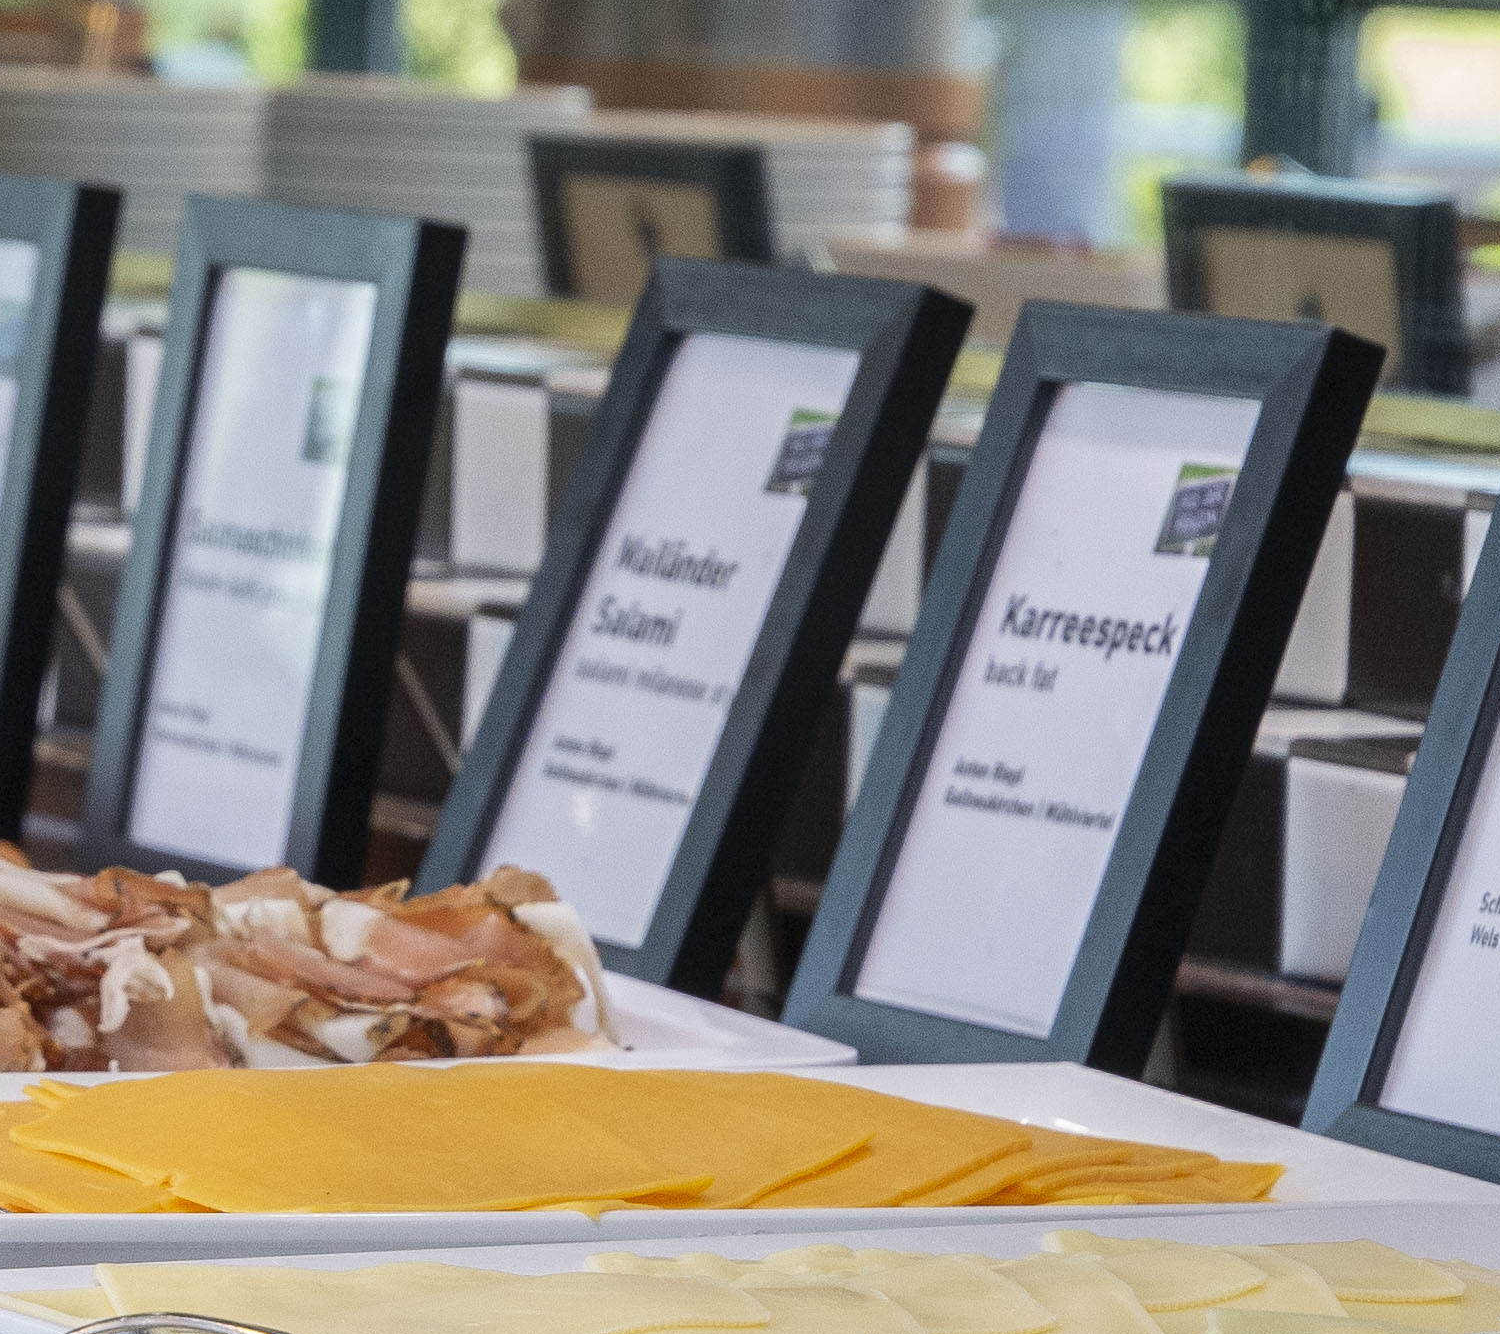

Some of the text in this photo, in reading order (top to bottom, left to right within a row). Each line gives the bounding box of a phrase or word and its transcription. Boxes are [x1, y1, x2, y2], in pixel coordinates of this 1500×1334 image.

[593, 594, 684, 646] Salami
[1000, 594, 1177, 660] Karreespeck
[1469, 923, 1499, 950] Wels
